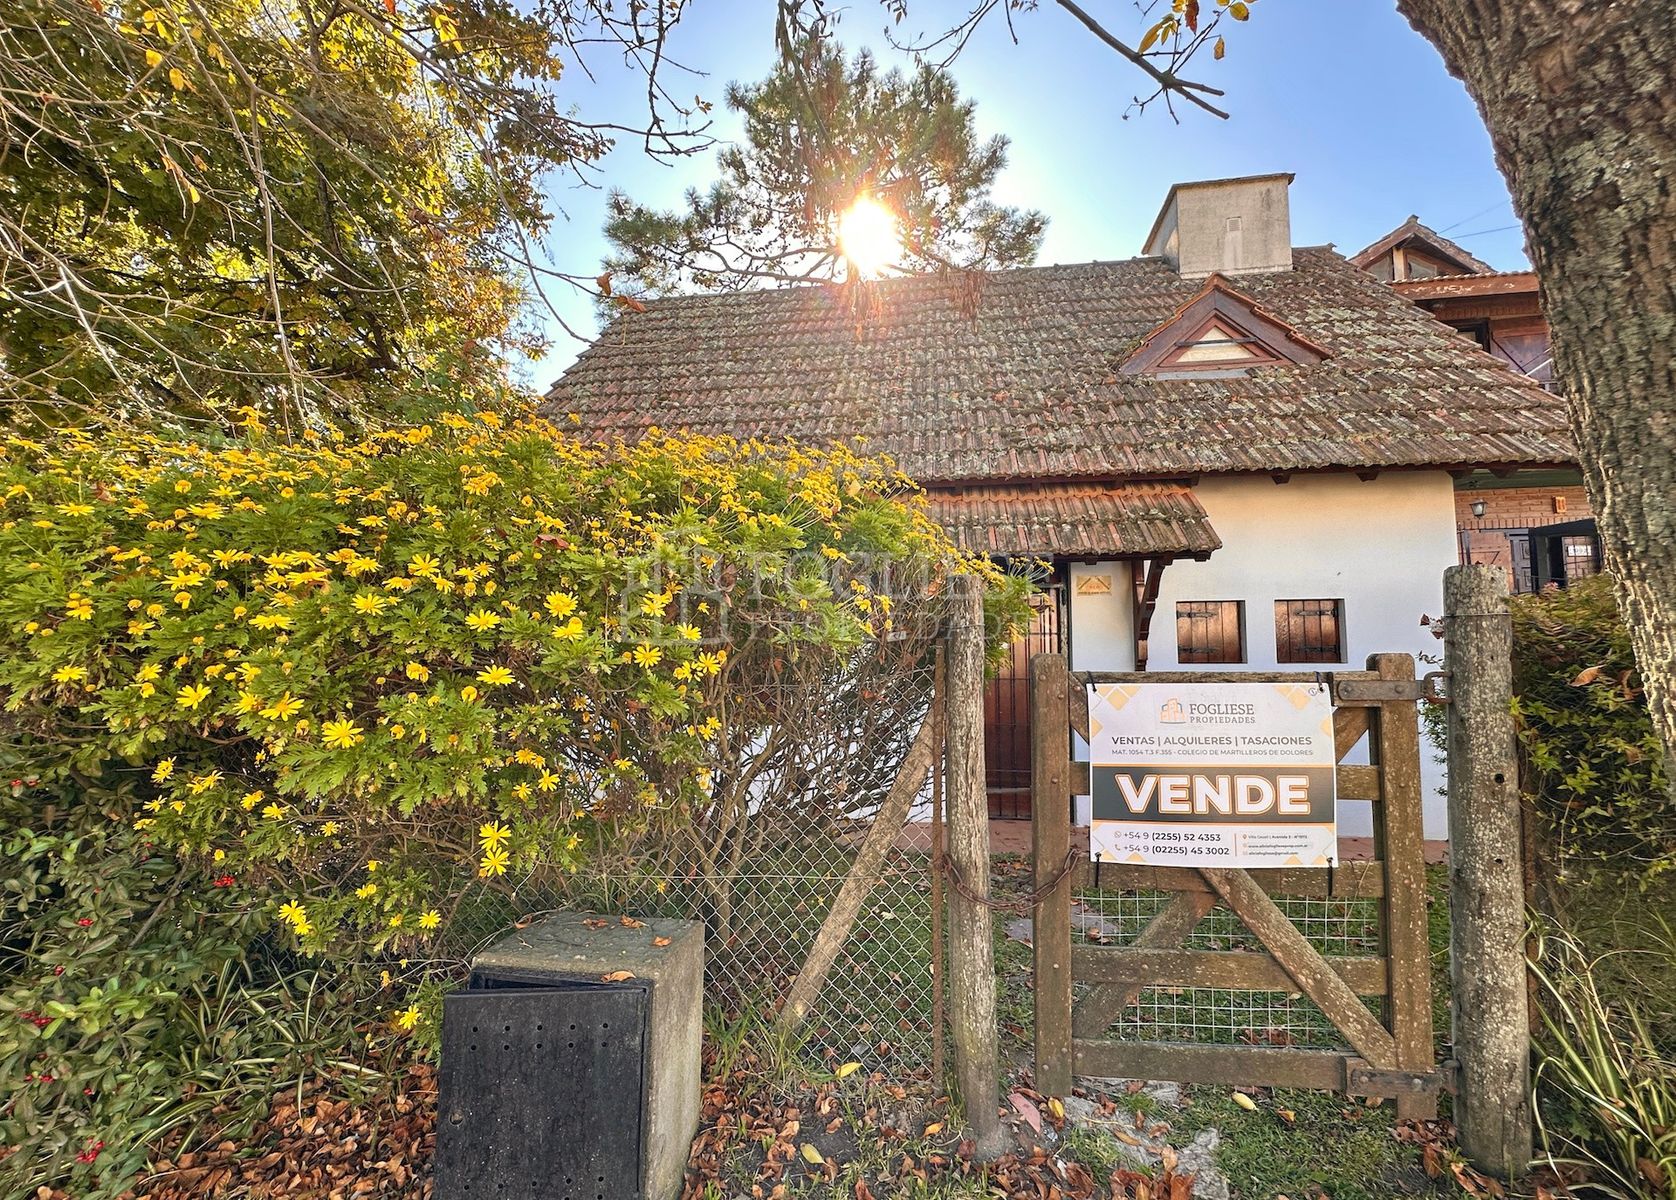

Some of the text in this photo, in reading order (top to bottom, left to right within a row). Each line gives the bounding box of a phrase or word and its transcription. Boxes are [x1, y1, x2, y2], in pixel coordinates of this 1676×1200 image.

[1189, 703, 1255, 715] FOGLIESE
[1189, 716, 1256, 724] PROPIEDADES
[1111, 736, 1155, 745] VENTAS
[1164, 736, 1232, 746] ALQUILERES
[1241, 736, 1312, 746] TASACIONES
[1115, 774, 1311, 815] VENDE
[1124, 831, 1221, 842] +54 9 (2255) 52 4353
[1124, 844, 1230, 855] +54 9 (02255) 45 3002
